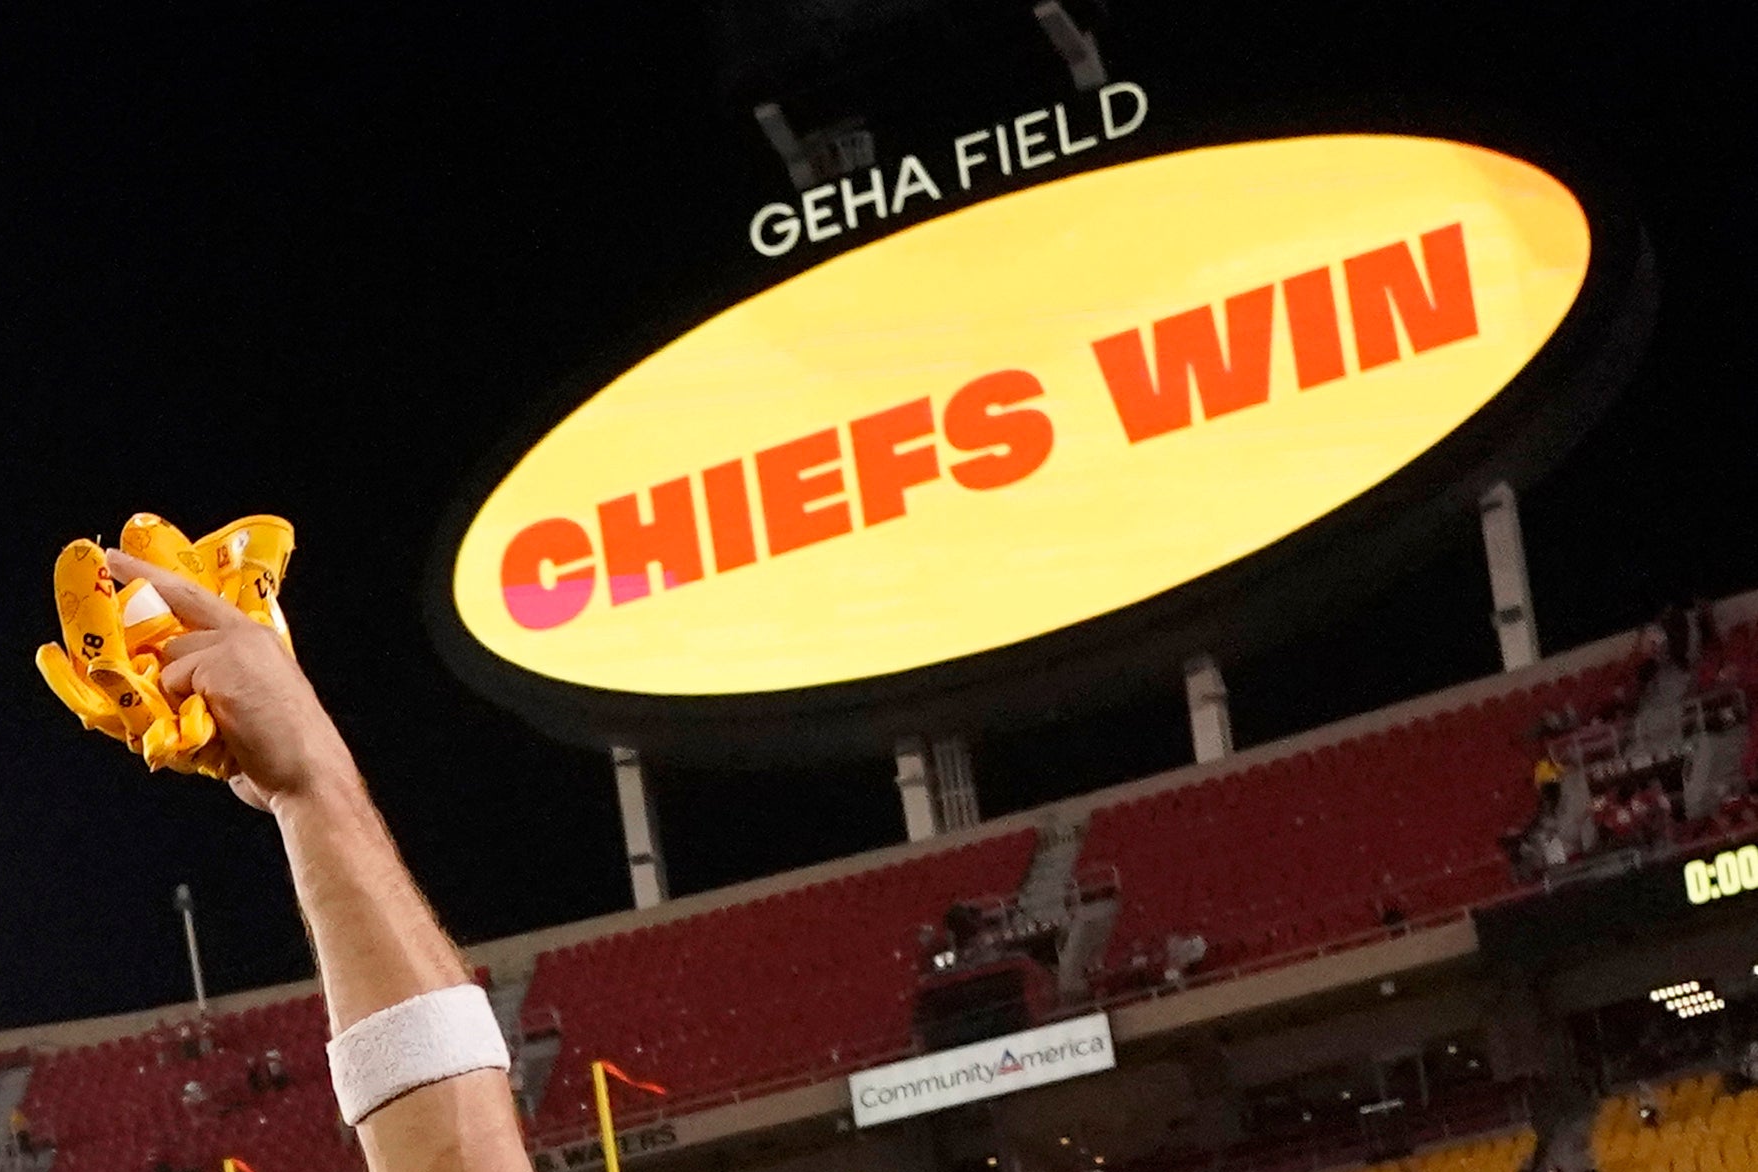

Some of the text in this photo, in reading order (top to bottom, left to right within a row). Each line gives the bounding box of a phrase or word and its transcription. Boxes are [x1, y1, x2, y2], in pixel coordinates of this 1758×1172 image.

[748, 81, 1149, 257] GEHA FIELD
[500, 221, 1480, 632] CHIEFS WIN
[1684, 844, 1758, 905] 0:00
[858, 1033, 1106, 1109] CommunityAmerica
